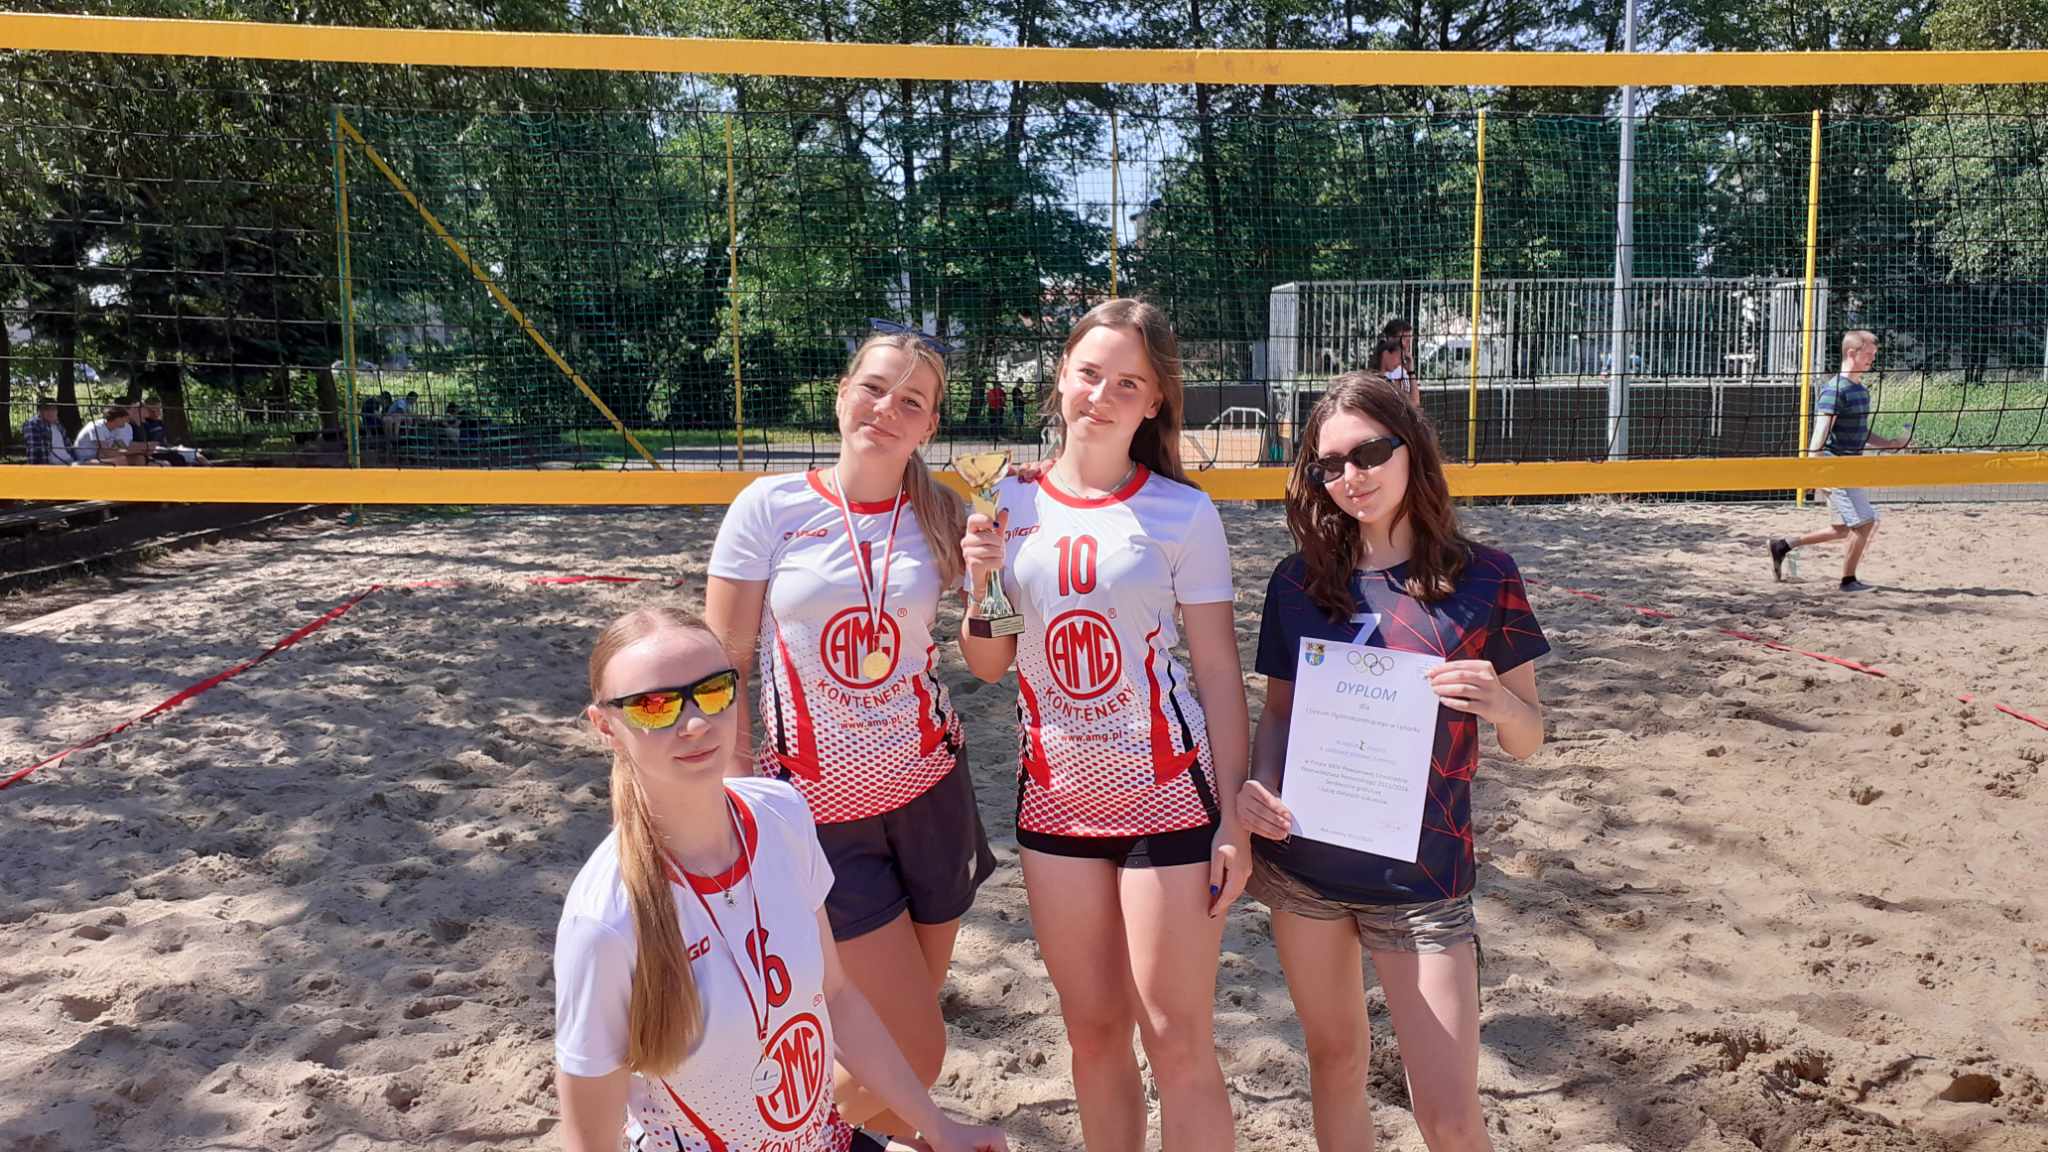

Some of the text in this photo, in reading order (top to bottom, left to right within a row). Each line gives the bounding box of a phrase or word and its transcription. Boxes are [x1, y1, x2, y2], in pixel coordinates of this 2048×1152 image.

[1054, 534, 1098, 596] 10
[1053, 621, 1114, 689] AMG
[818, 675, 908, 709] KONTENERY
[1045, 684, 1136, 721] KONTENERY
[1336, 680, 1398, 702] DYPLOM
[841, 714, 901, 729] www.amg.pl
[1062, 730, 1122, 743] www.amg.pl
[745, 927, 792, 1007] 6
[767, 1026, 819, 1119] AMG
